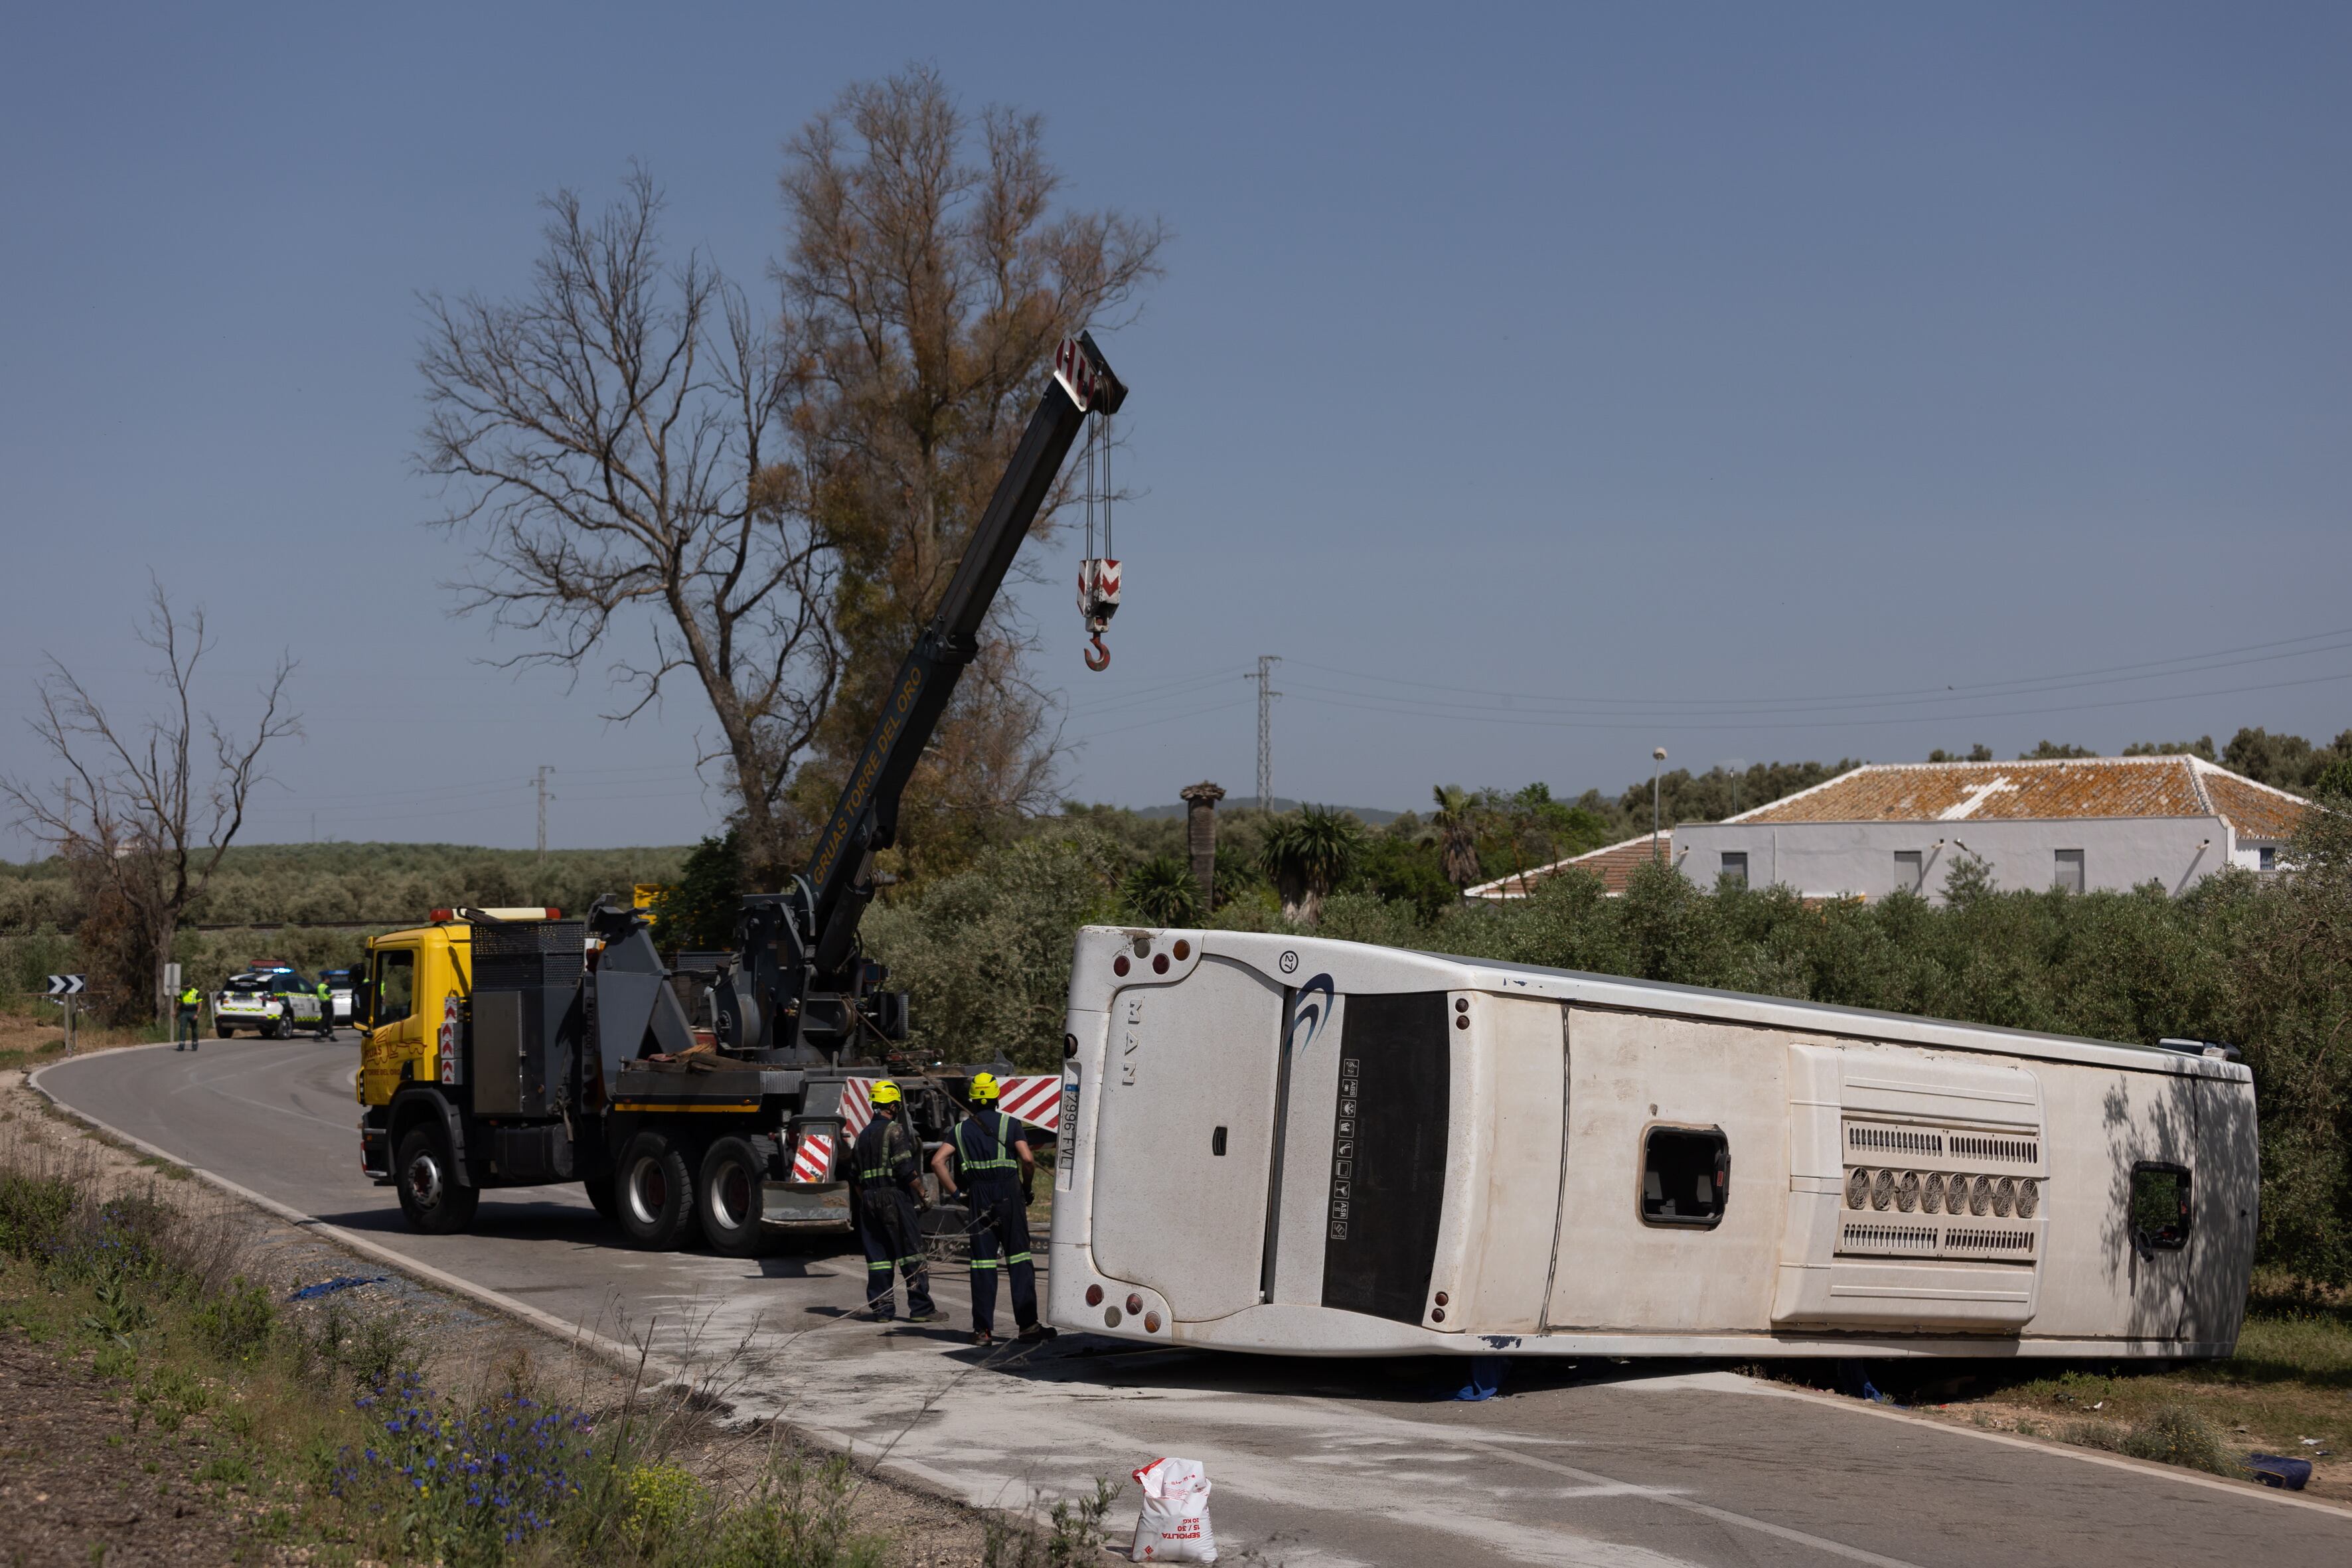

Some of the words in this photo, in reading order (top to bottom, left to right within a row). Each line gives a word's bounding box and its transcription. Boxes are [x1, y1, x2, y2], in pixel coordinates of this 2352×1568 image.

[814, 817, 848, 885] GRUAS
[844, 750, 880, 817] TORRE
[877, 715, 901, 754] DEL
[897, 666, 921, 712] ORO
[1285, 955, 1293, 970] 27
[1122, 998, 1142, 1085] MAN
[1064, 1095, 1078, 1131] 7996
[1061, 1137, 1075, 1164] FVL
